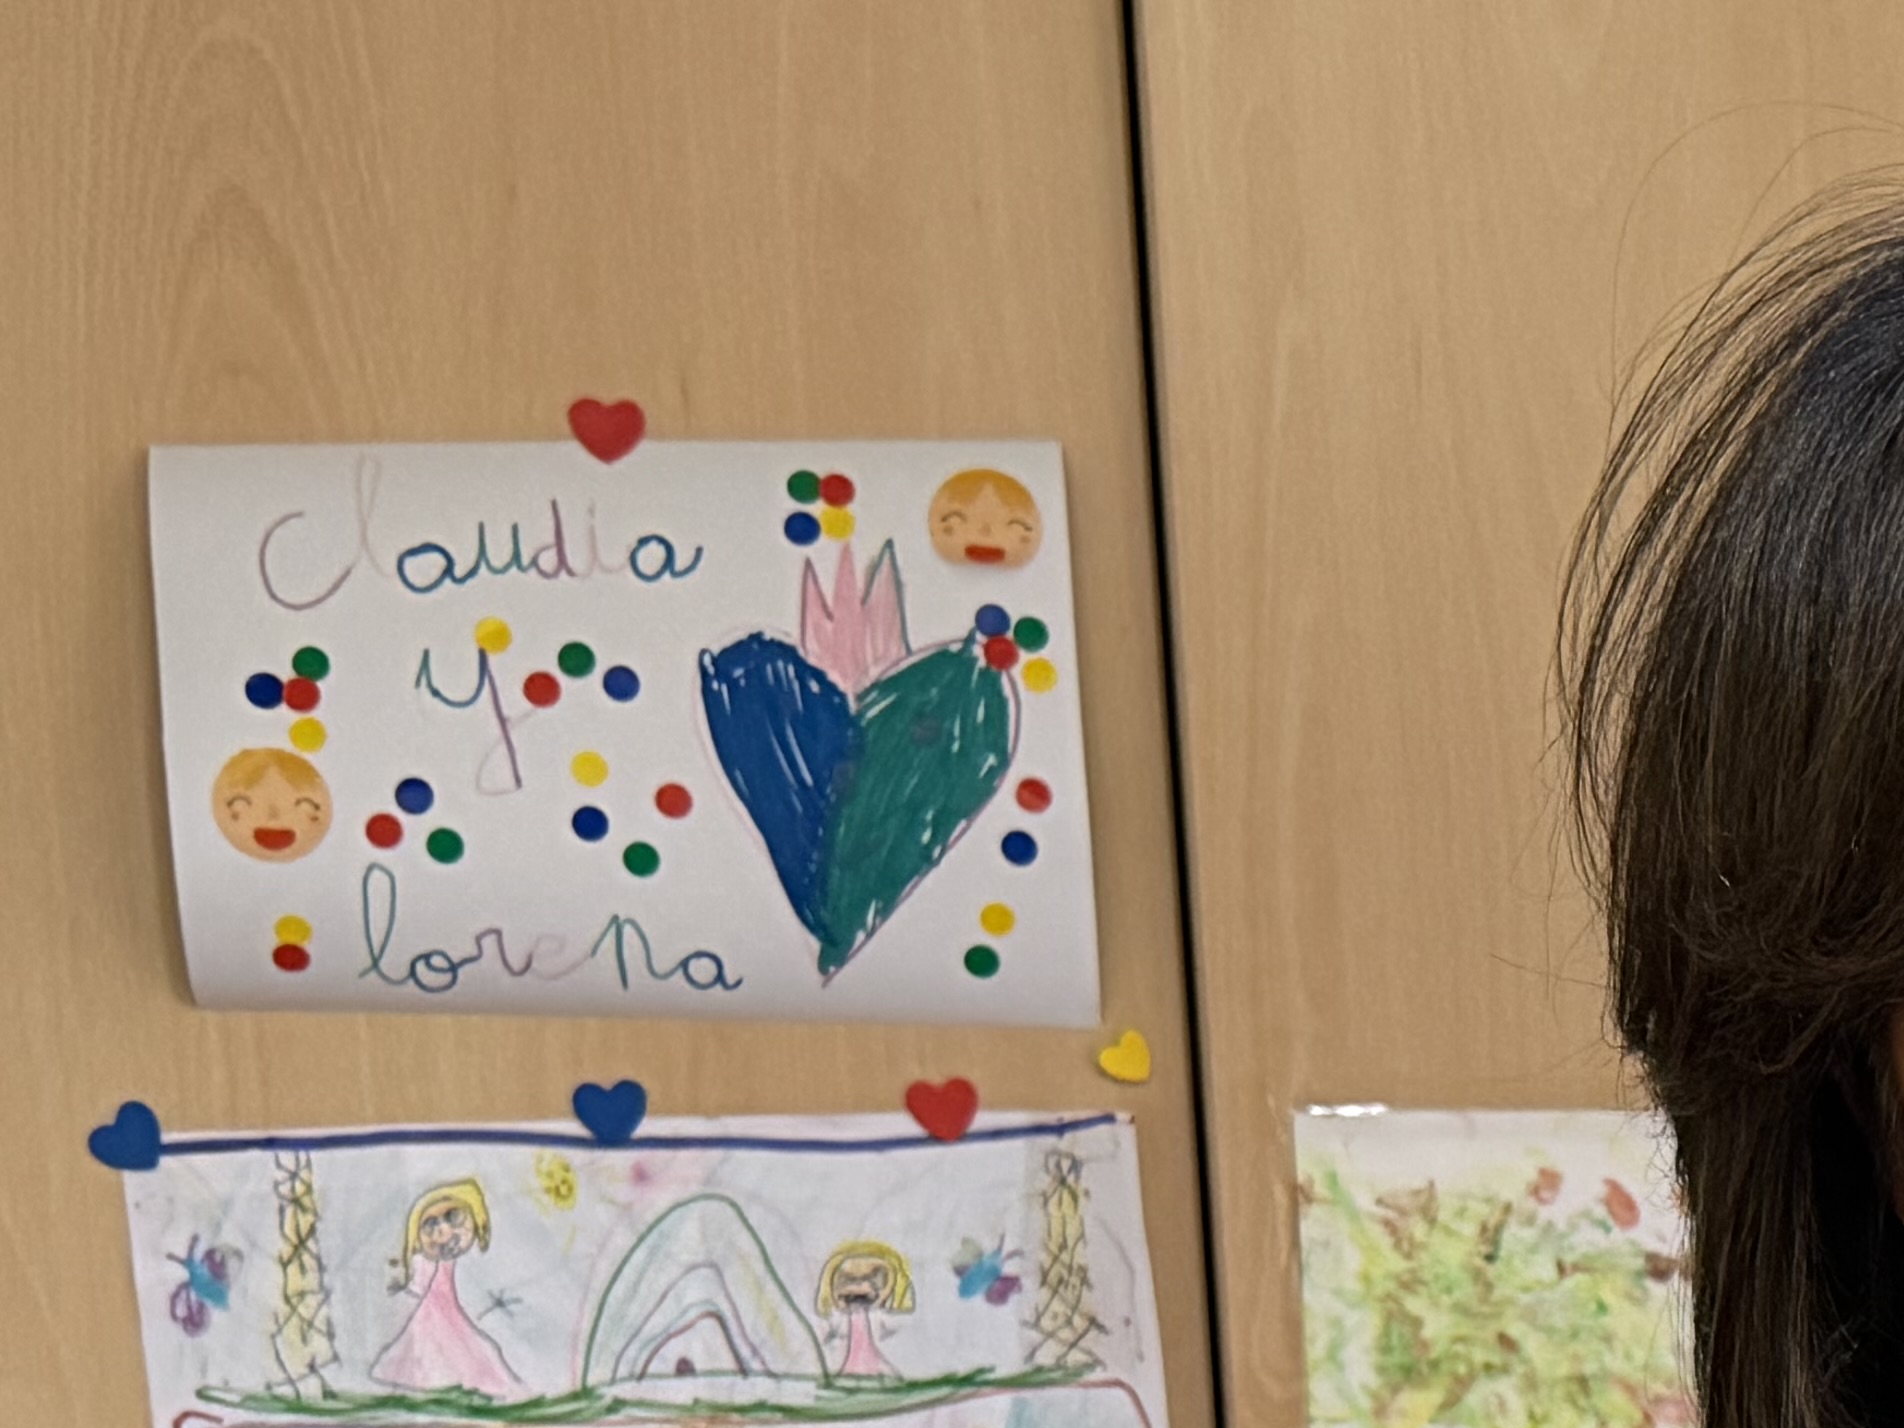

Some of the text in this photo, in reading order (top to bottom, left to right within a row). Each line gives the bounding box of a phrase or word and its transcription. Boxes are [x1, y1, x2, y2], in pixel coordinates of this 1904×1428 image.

[259, 453, 704, 611] Claudia
[414, 646, 539, 796] y
[359, 863, 743, 992] lorena
